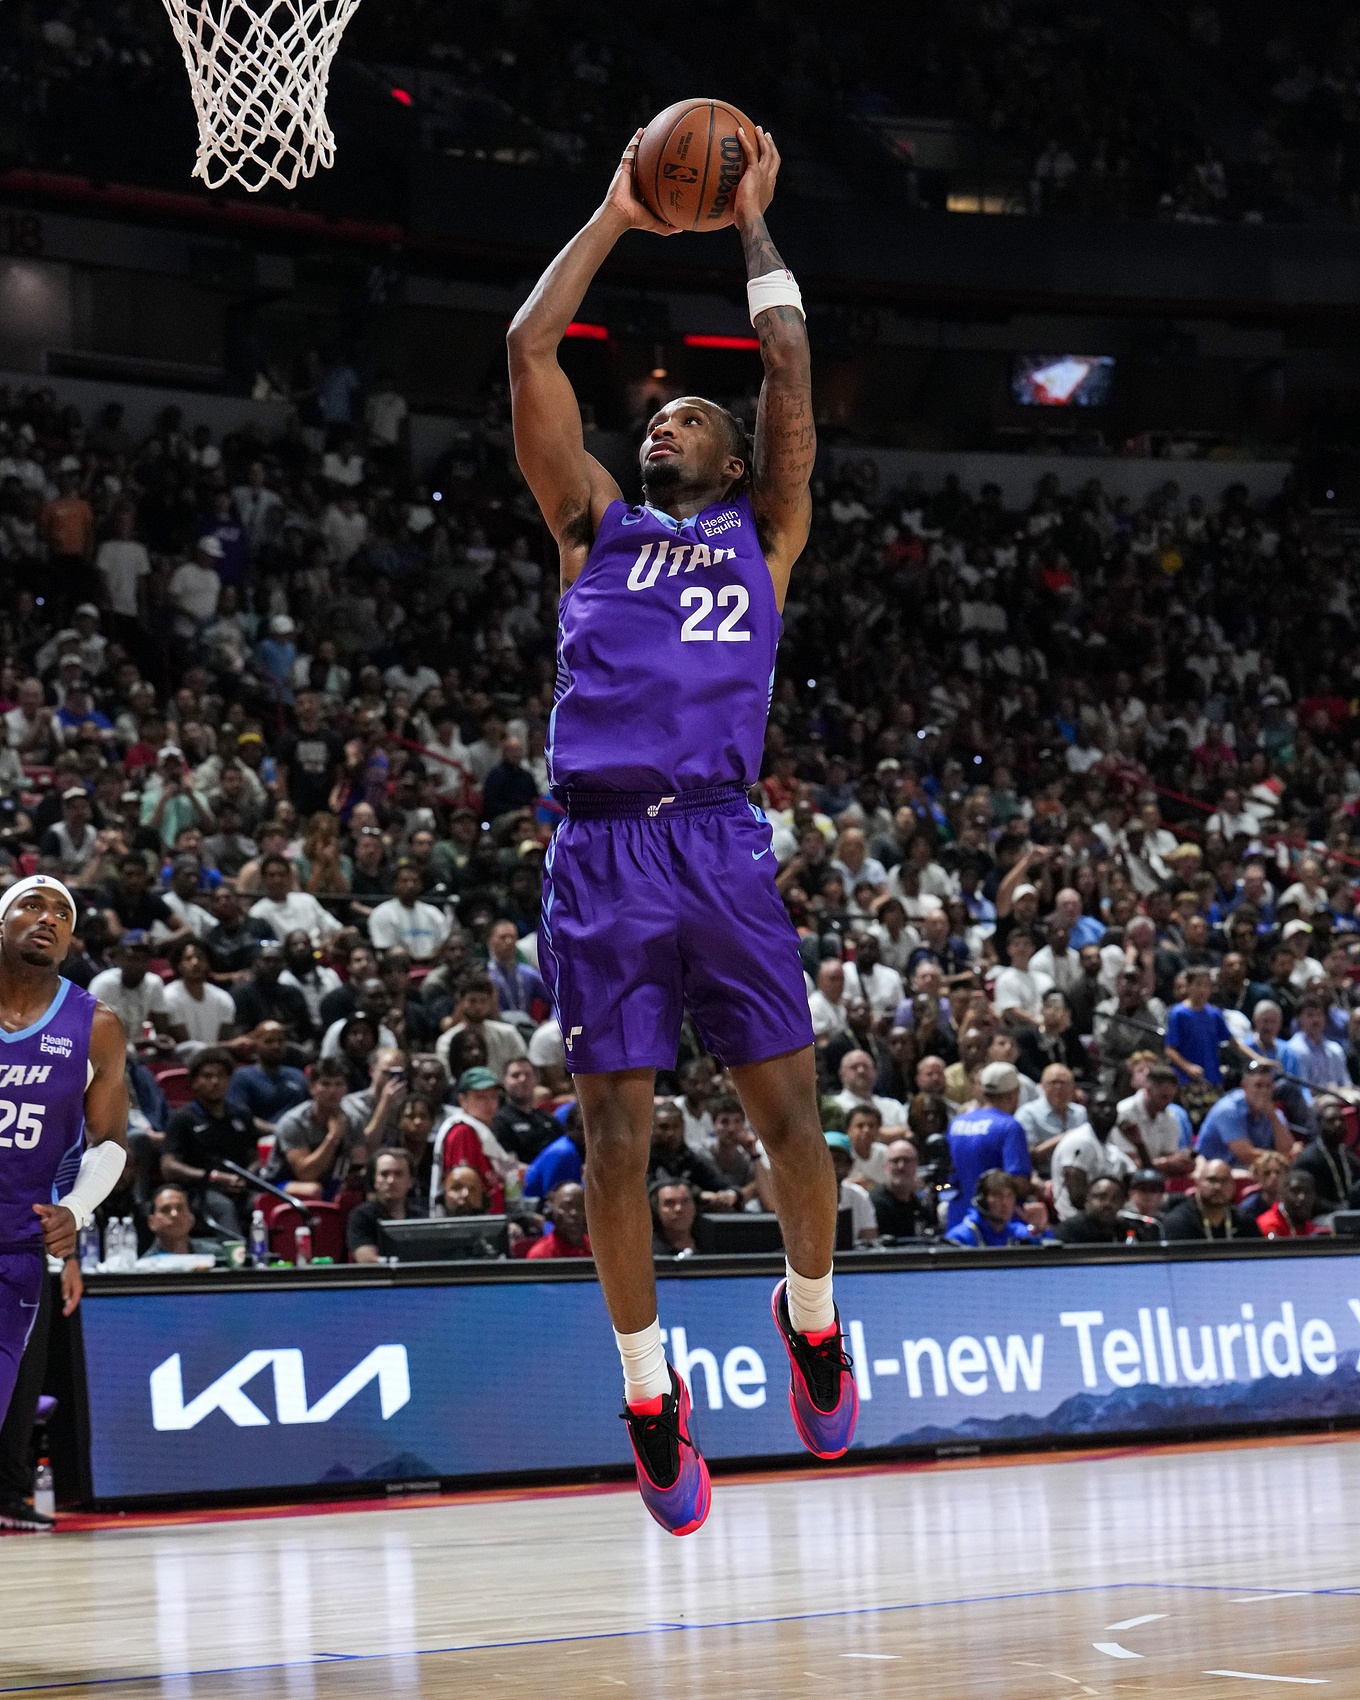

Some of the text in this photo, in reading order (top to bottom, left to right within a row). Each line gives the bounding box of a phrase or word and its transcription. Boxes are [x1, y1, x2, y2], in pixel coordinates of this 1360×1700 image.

[707, 135, 742, 220] Wilson
[700, 510, 739, 530] Health
[704, 518, 742, 537] Equity
[627, 540, 737, 591] UTAH
[680, 585, 751, 642] 22
[40, 1042, 72, 1058] Equity
[41, 1033, 73, 1048] Health
[659, 1326, 767, 1410] he
[841, 1319, 1045, 1401] l-new
[1059, 1301, 1338, 1388] Telluride
[150, 1343, 411, 1432] KIA
